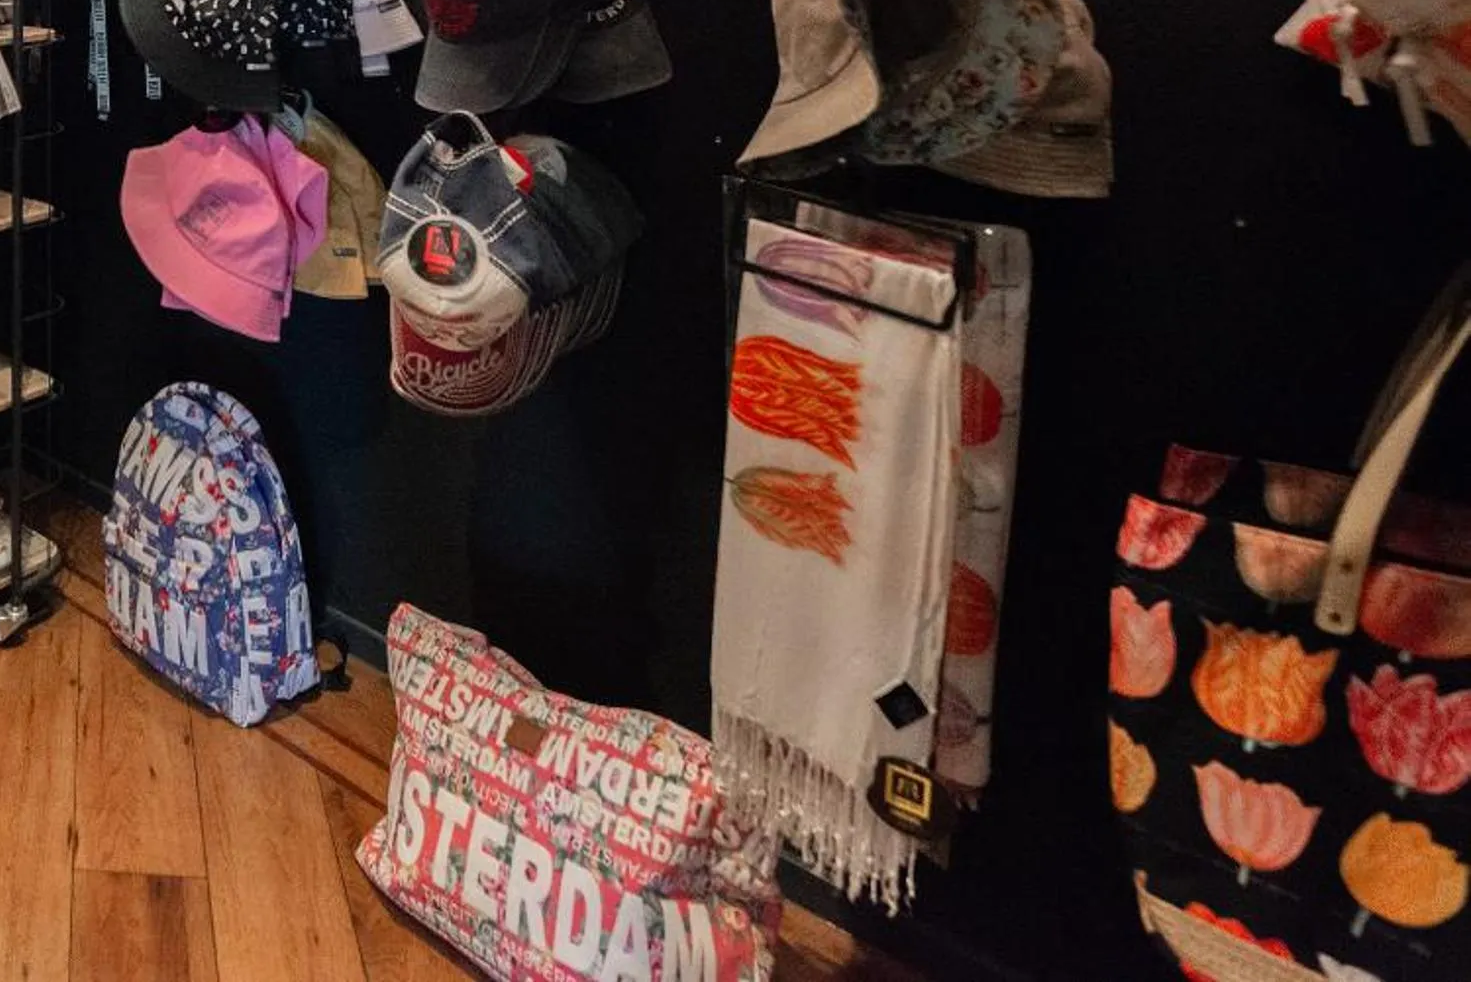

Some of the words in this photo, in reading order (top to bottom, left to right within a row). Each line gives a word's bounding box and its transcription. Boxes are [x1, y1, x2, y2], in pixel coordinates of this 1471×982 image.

[404, 345, 505, 397] Bicycle
[106, 555, 210, 679] DAM
[401, 704, 532, 790] AMSTERDAM
[390, 758, 720, 982] STERDAM
